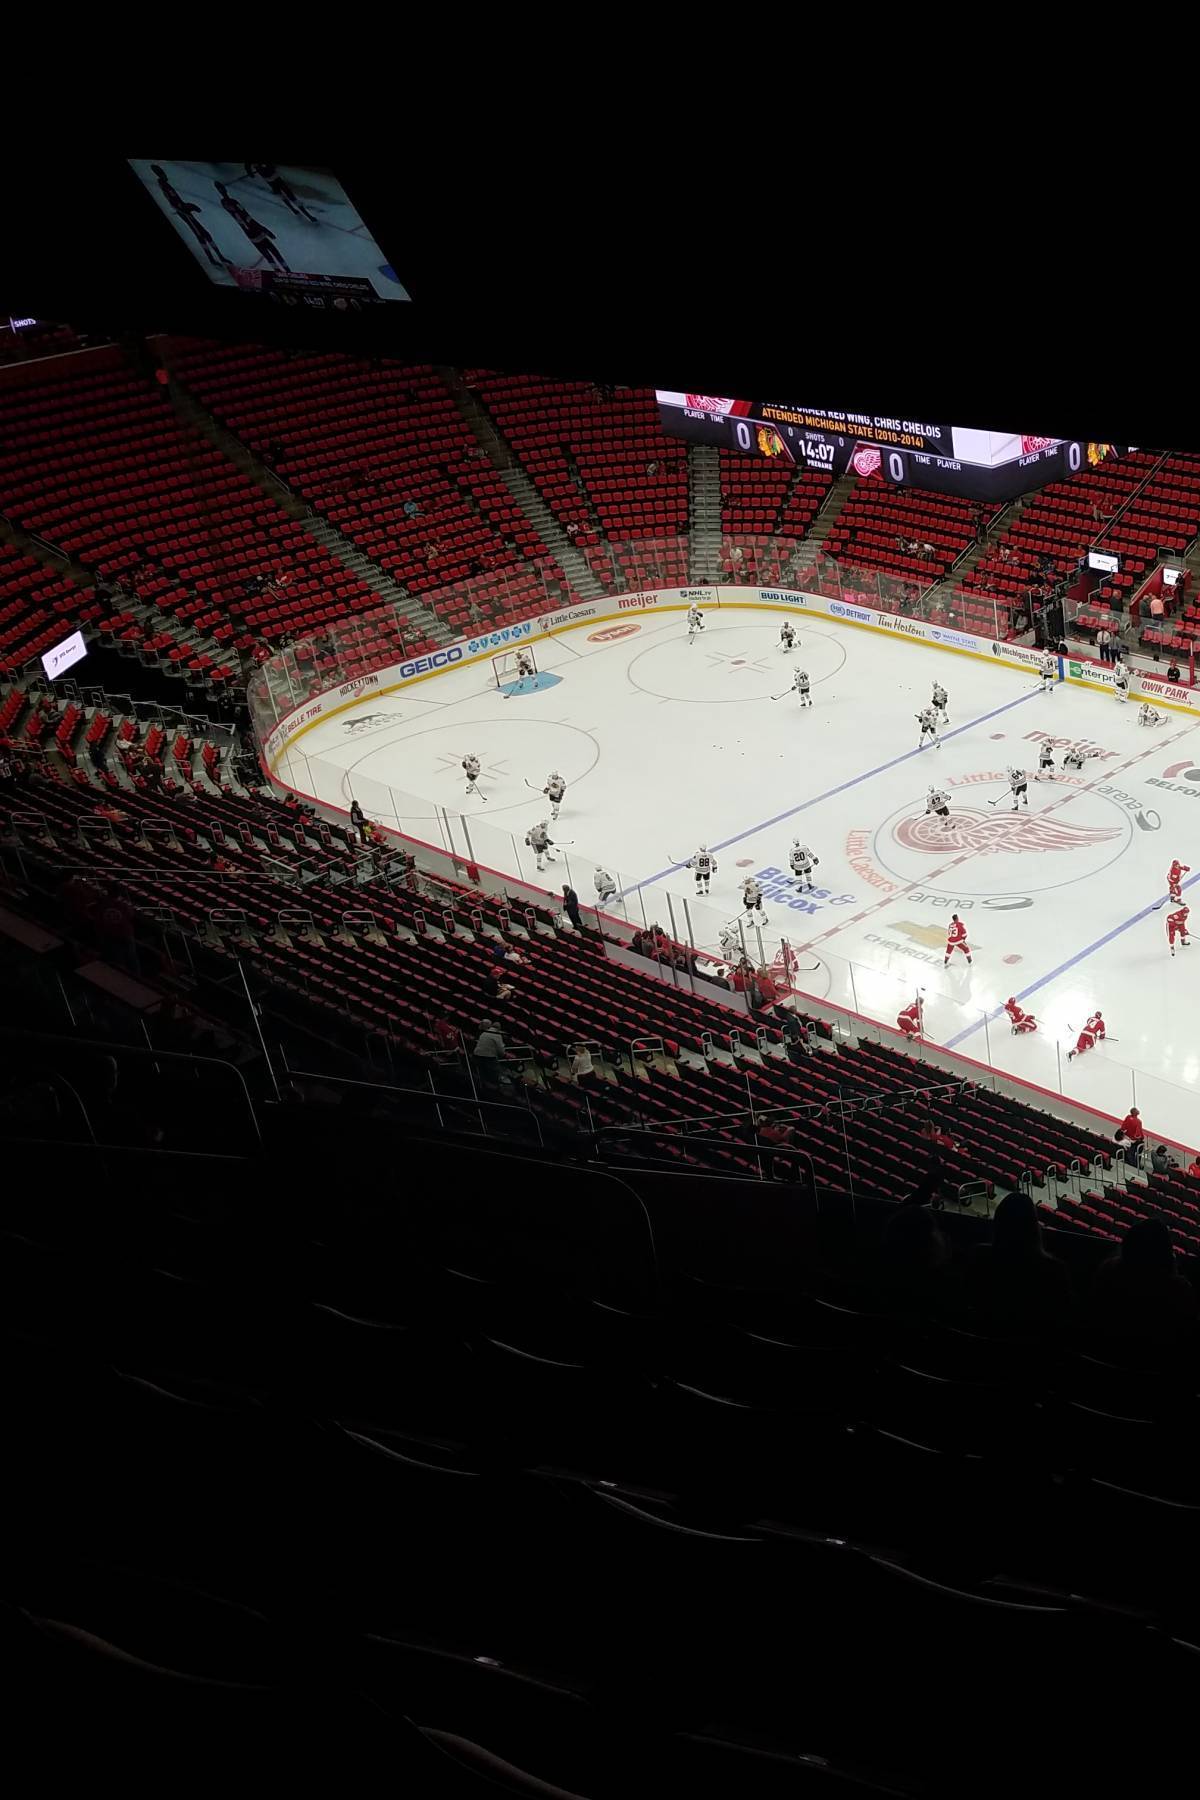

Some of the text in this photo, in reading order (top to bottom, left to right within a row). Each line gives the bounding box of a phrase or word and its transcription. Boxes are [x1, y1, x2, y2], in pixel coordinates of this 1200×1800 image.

[684, 409, 725, 424] PLAYER TIME
[874, 416, 901, 432] CHRIS
[902, 421, 941, 438] CHELOIS
[736, 422, 751, 450] 0
[762, 407, 924, 448] ATTENDED MICHIGAN STATE (2010-2014)
[805, 432, 825, 442] SHOTS
[799, 439, 835, 462] 14:07
[1019, 446, 1058, 467] PLAYER TIME
[1069, 442, 1081, 471] 0
[889, 453, 903, 482] 0
[914, 454, 961, 471] TIME PLAYER
[618, 593, 658, 609] meijer
[760, 592, 805, 604] BUD LIGHT
[550, 607, 596, 626] Little Caesars
[846, 608, 871, 622] DETROIT
[877, 613, 926, 638] Tim Hortons
[400, 647, 462, 678] GEICO
[1002, 645, 1029, 660] Michigan
[339, 674, 379, 697] HOCKEYTOWN
[1141, 680, 1190, 701] QWIK PARK
[287, 703, 323, 733] BELLE TIRE
[1097, 784, 1144, 810] arena
[699, 858, 710, 867] 88
[793, 851, 805, 862] 20
[829, 894, 857, 906] &
[907, 891, 974, 909] arena
